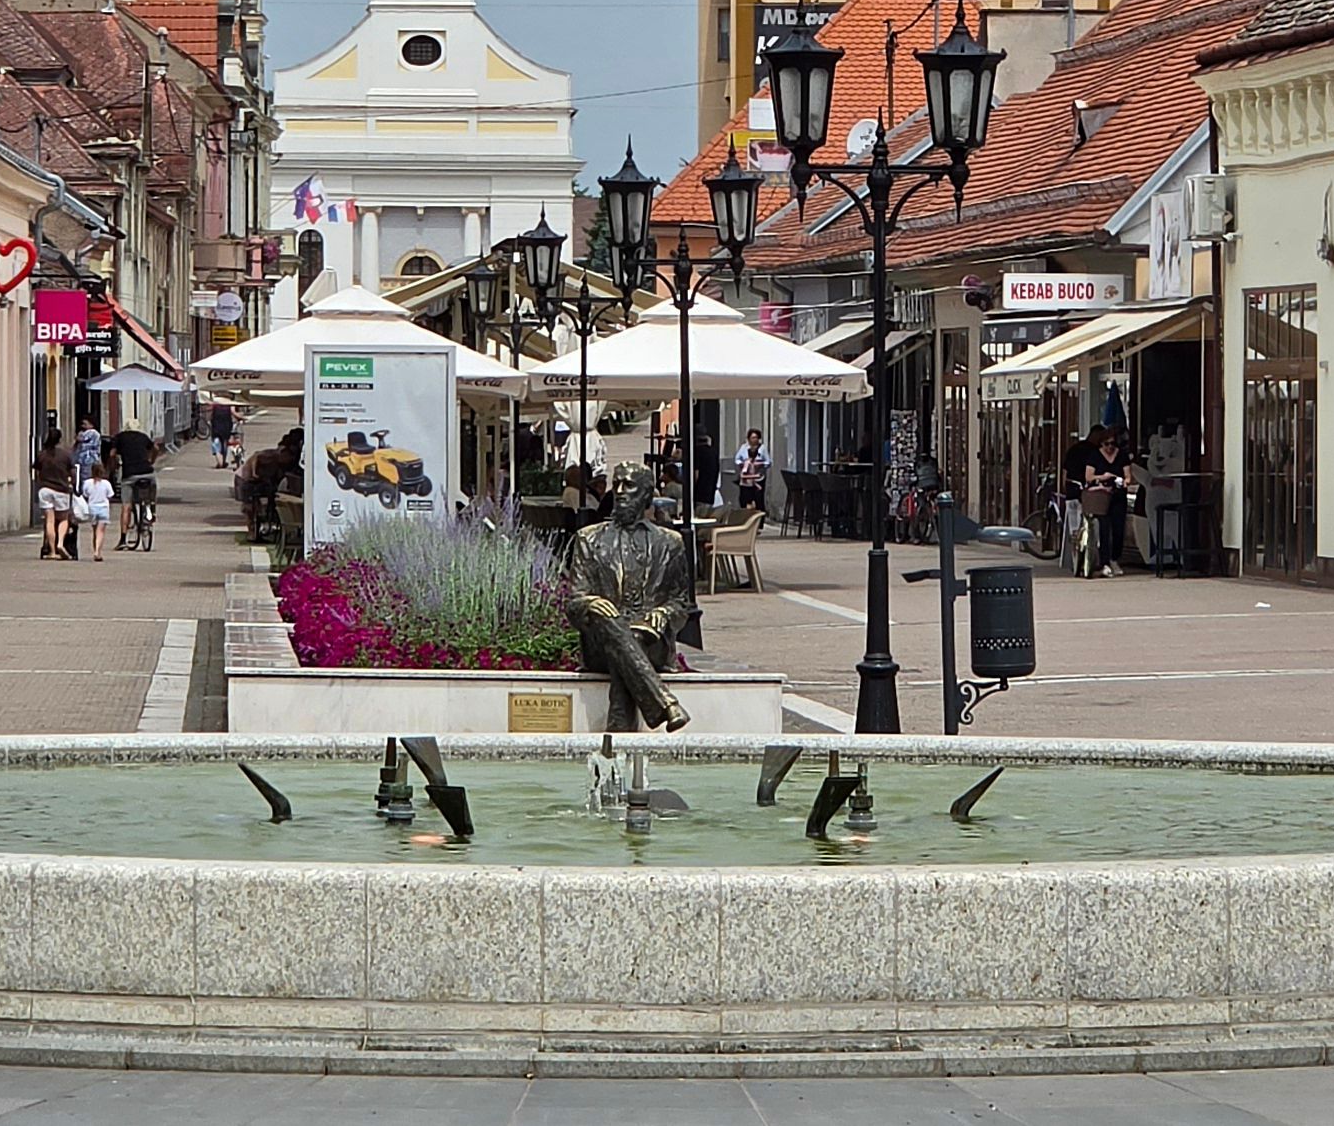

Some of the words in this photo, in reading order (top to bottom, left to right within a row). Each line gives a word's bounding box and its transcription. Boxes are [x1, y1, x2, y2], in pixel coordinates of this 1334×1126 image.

[762, 8, 798, 25] MD
[1011, 282, 1053, 300] KEBAB
[1058, 282, 1095, 300] BUCO
[37, 323, 83, 340] BIPA
[326, 363, 367, 372] PEVEX
